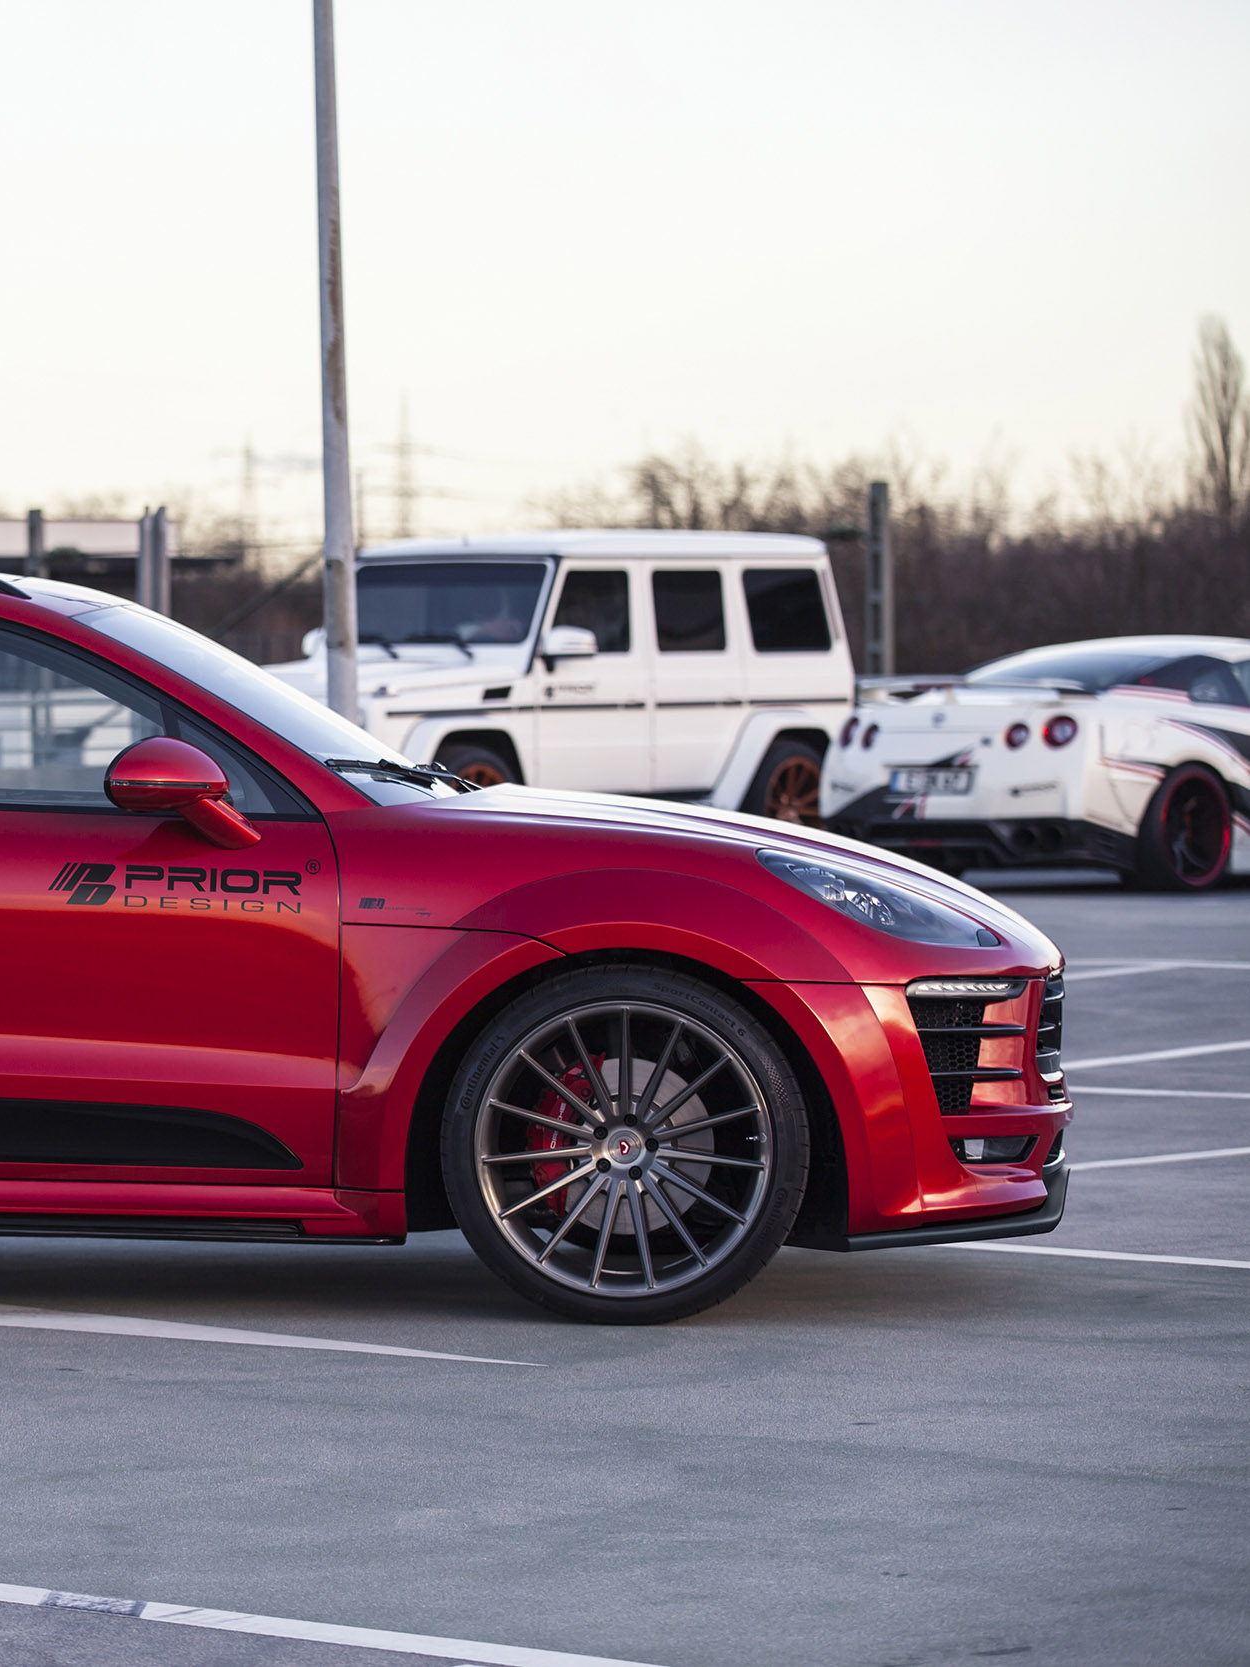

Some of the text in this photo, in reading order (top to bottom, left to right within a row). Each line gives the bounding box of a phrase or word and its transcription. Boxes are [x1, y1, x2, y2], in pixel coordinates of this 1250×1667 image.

[125, 865, 302, 896] PRIOR
[124, 895, 301, 914] DESIGN
[653, 982, 747, 1038] SportContact 6
[460, 1041, 500, 1109] Continental
